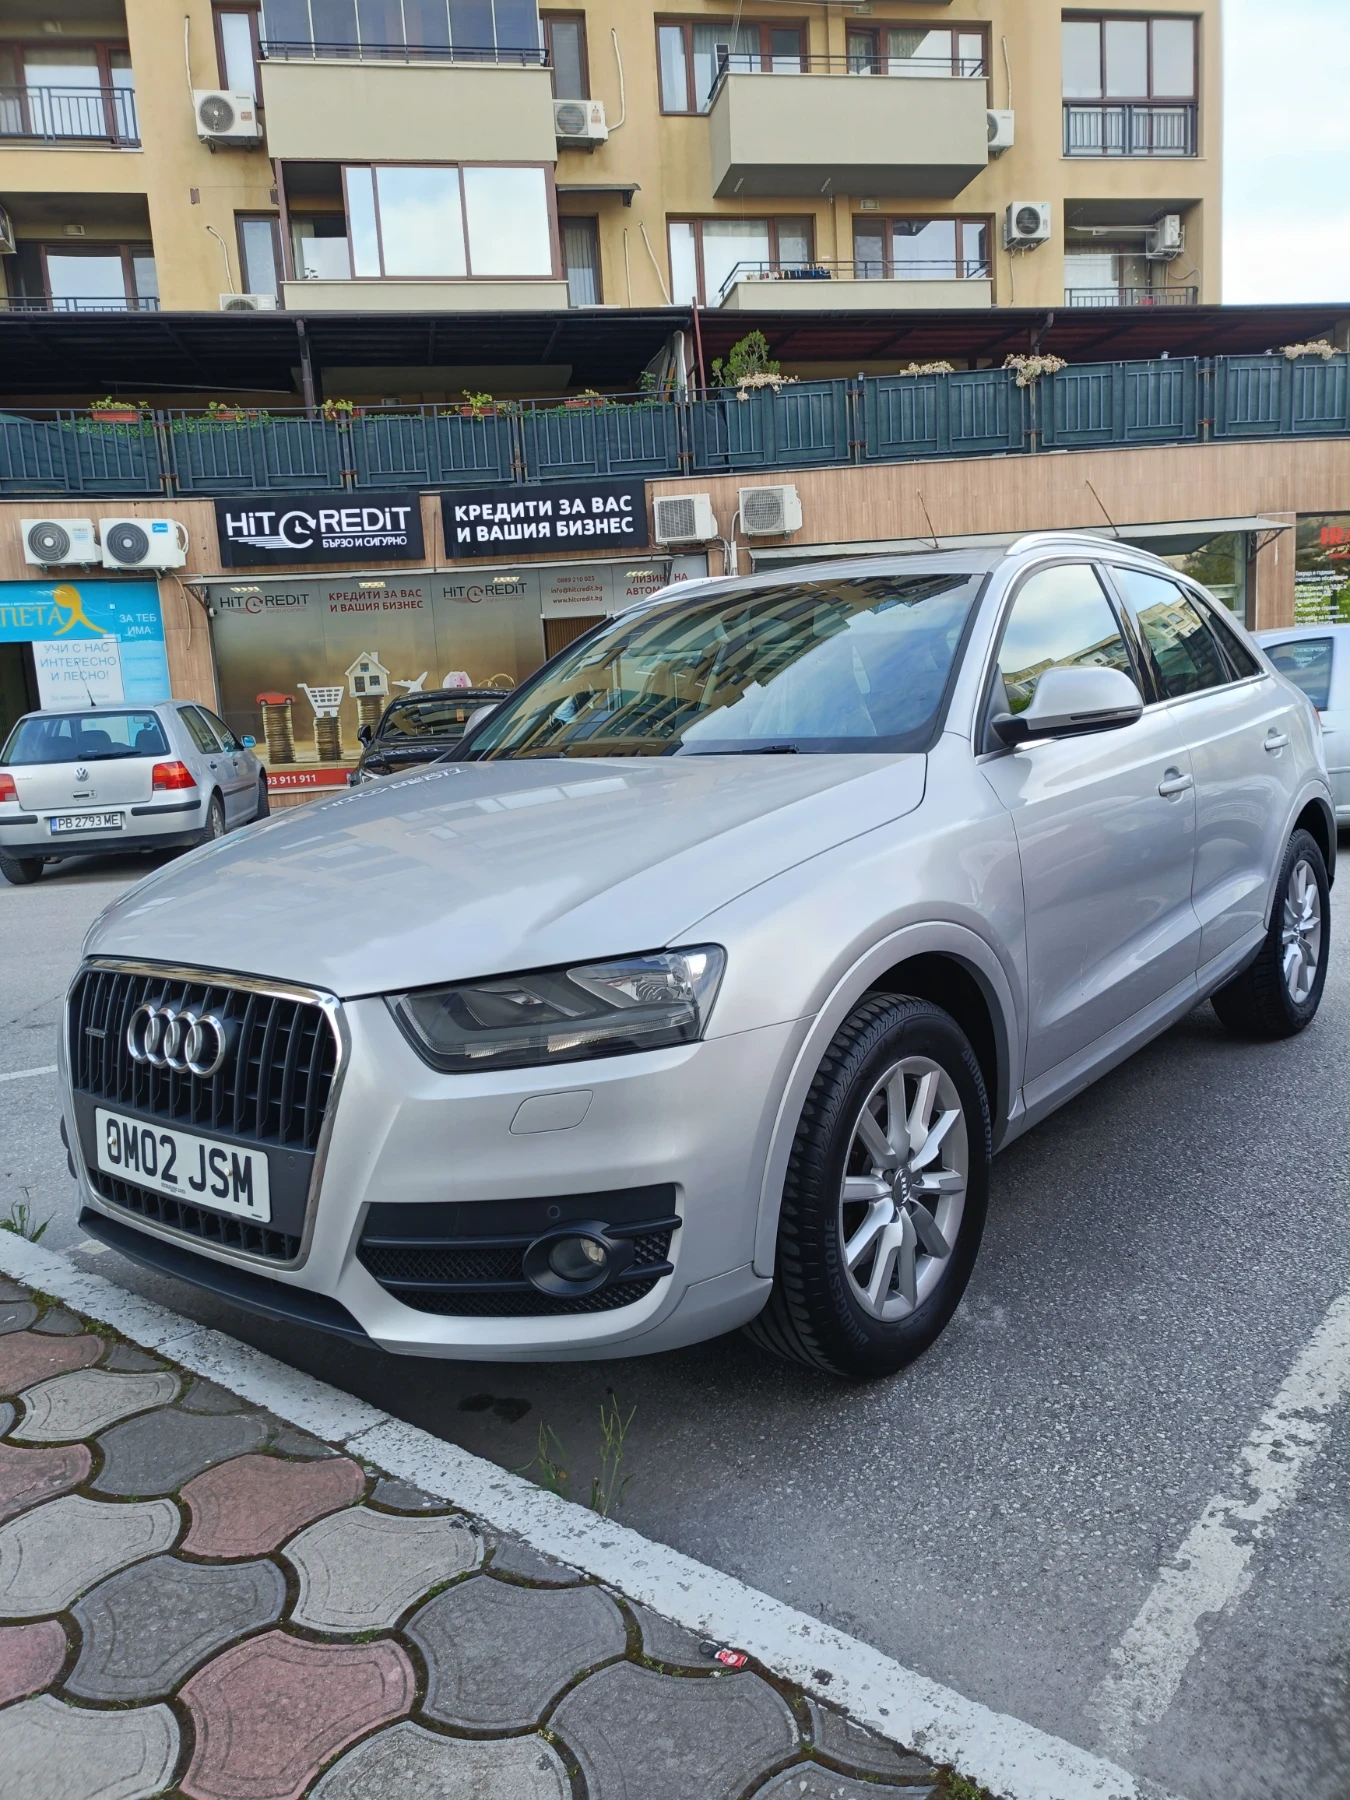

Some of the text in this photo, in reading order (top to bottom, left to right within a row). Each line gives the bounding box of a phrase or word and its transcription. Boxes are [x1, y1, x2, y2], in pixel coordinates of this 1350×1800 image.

[454, 495, 633, 522] КРЕДИТИ ЗА ВАС
[456, 516, 634, 543] И ВАШИЯ БИЗНЕС
[1320, 526, 1350, 544] IR
[322, 535, 407, 548] БЪРЗО И СИГУРНО
[631, 572, 688, 584] ЛИЗИН НА
[328, 588, 422, 602] КРЕДИТИ ЗА ВАС
[550, 585, 603, 594] info@hitcredit.bg
[552, 595, 603, 604] www.hitcredit.bg
[330, 600, 424, 613] И ВАШИЯ БИЗНЕС
[0, 606, 66, 627] ПЕТА
[119, 613, 157, 623] ЗА ТЕБ
[44, 642, 110, 654] УЧИ С НАС
[40, 656, 117, 668] ИНТЕРЕСНО
[50, 670, 109, 681] И ЛЕСНО!
[279, 775, 297, 784] 911
[299, 774, 316, 783] 911
[58, 814, 119, 829] PB 2793 ME
[188, 1143, 254, 1207] JSM
